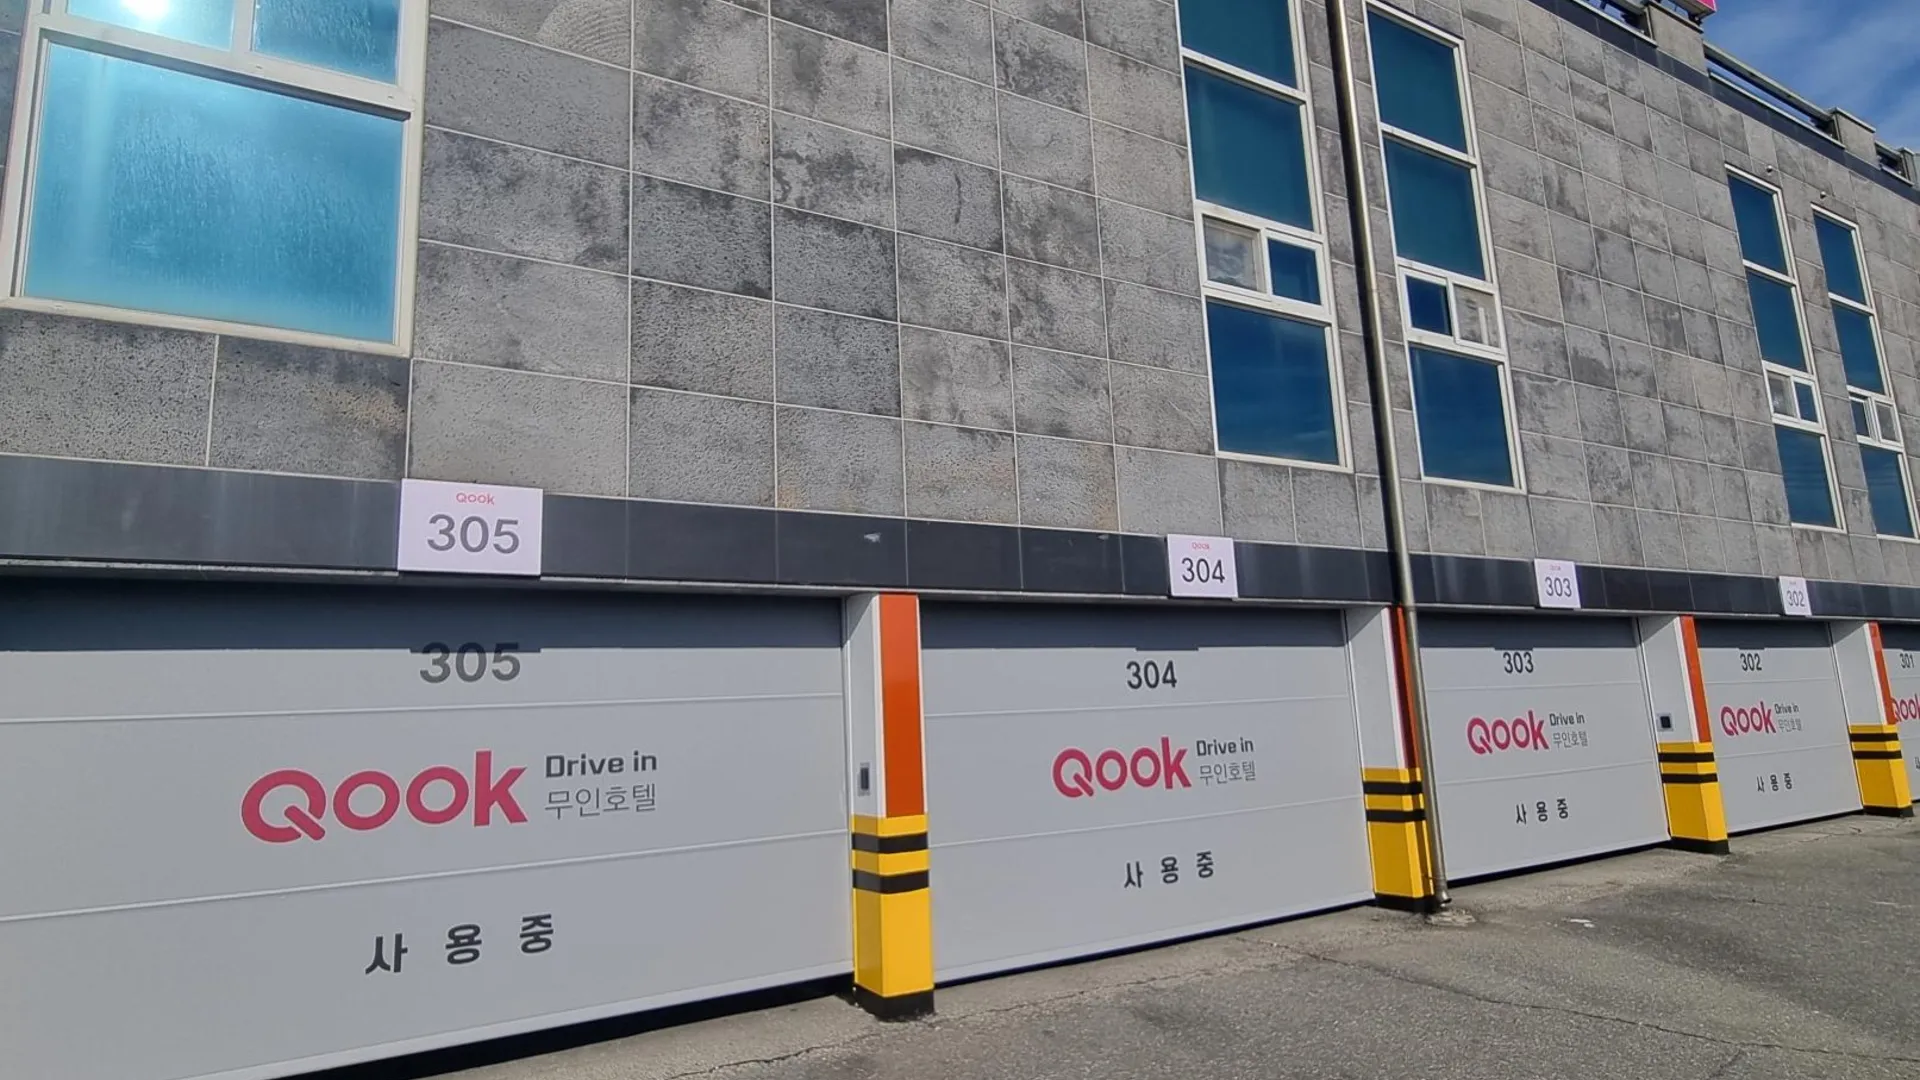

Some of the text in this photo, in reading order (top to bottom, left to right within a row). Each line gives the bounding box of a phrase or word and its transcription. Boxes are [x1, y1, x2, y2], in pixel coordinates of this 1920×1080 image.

[456, 491, 496, 506] Qook
[427, 513, 521, 554] 305
[1181, 557, 1226, 584] 304
[1545, 576, 1572, 597] 303
[1787, 590, 1805, 607] 302
[420, 641, 522, 684] 305
[1503, 651, 1534, 674] 303
[1740, 653, 1762, 672] 302
[1900, 653, 1914, 669] 301
[1126, 660, 1177, 690] 304
[1549, 711, 1585, 726] Drive in
[1720, 701, 1777, 736] Qook
[1466, 710, 1550, 755] Qook
[1196, 738, 1254, 756] Drive in
[545, 749, 657, 779] Drive in
[1053, 736, 1192, 798] Qook
[1198, 761, 1256, 786] 무인호텔
[241, 750, 528, 843] Qook
[544, 782, 657, 820] 무인호텔
